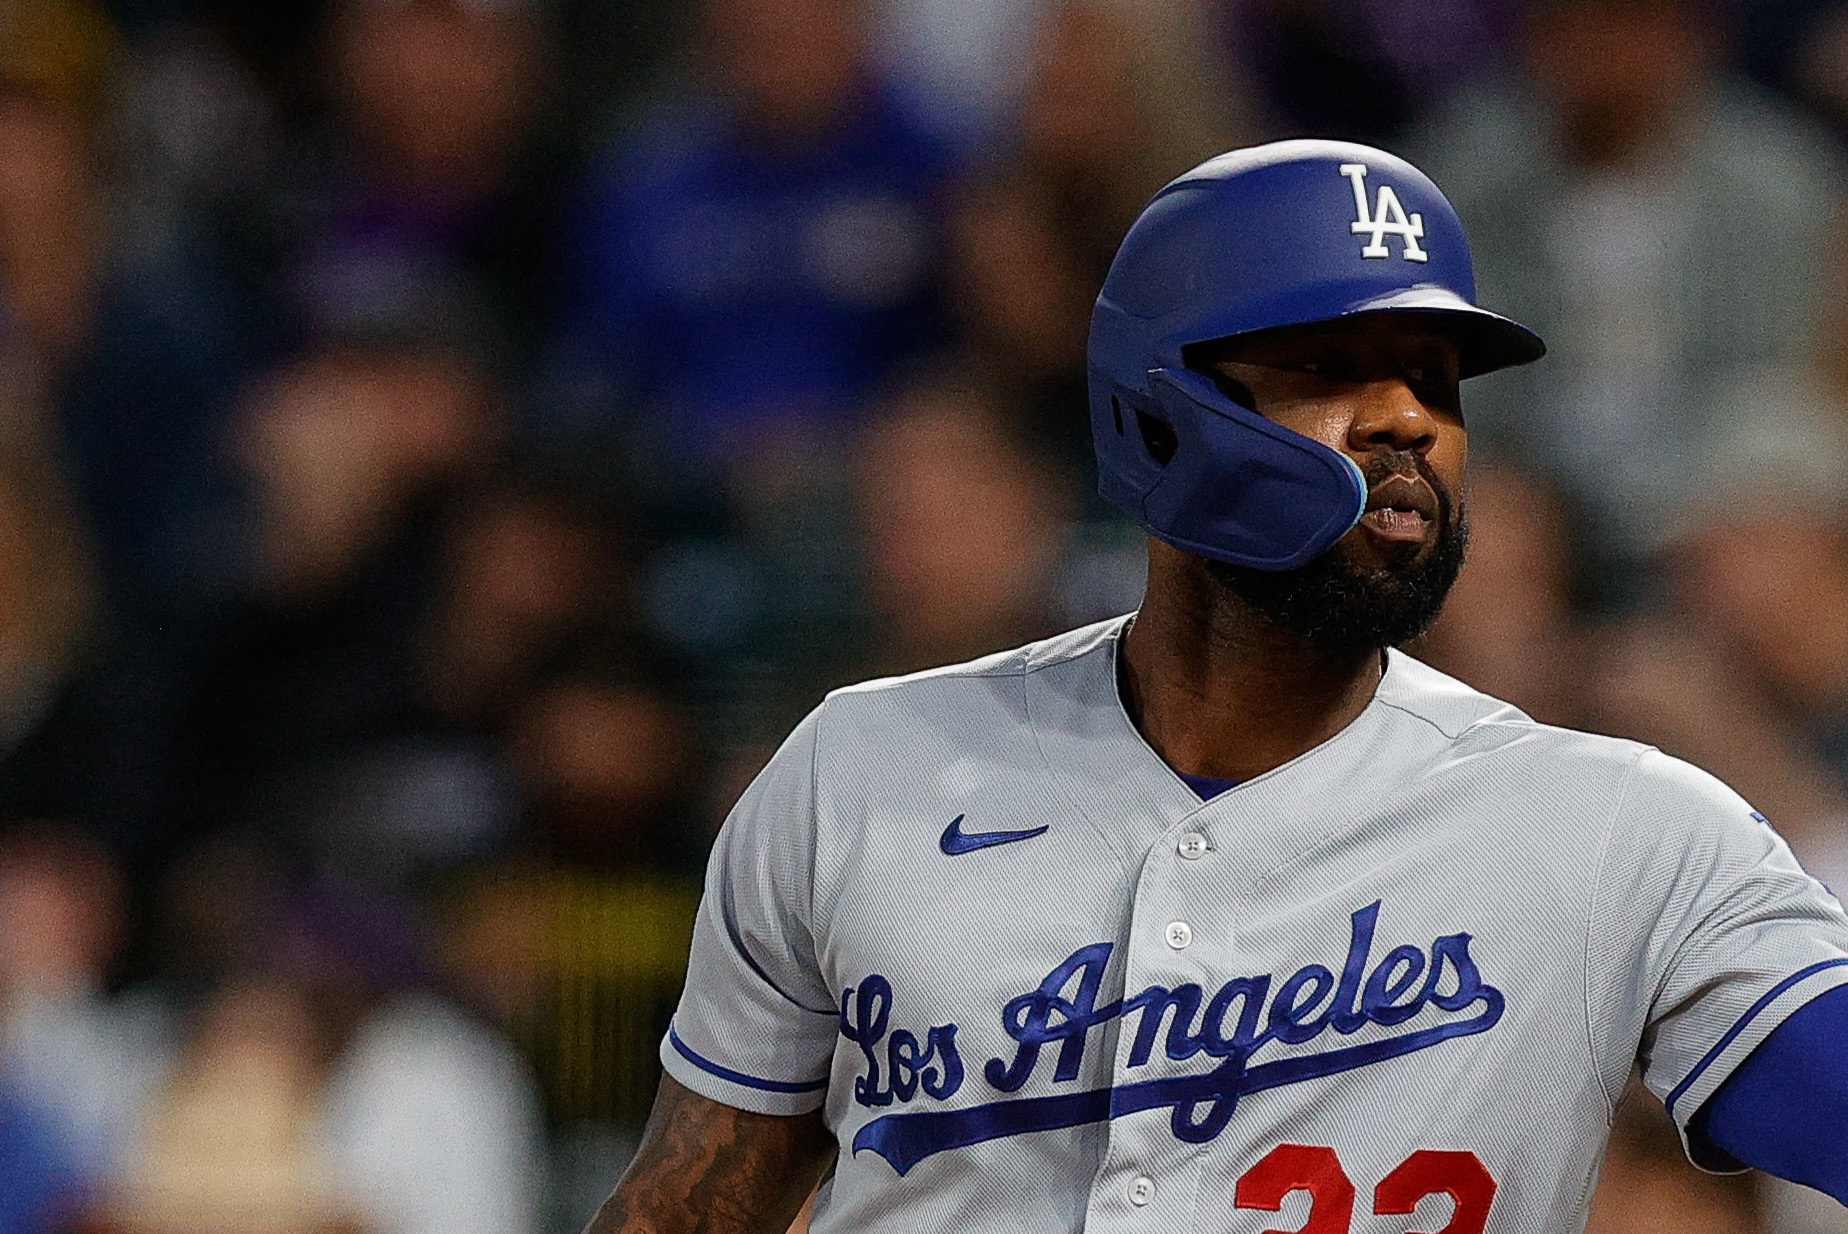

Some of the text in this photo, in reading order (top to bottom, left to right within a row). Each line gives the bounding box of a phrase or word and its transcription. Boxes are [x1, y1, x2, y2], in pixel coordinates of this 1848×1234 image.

[1339, 163, 1428, 262] LA
[840, 900, 1505, 1143] Los Angeles
